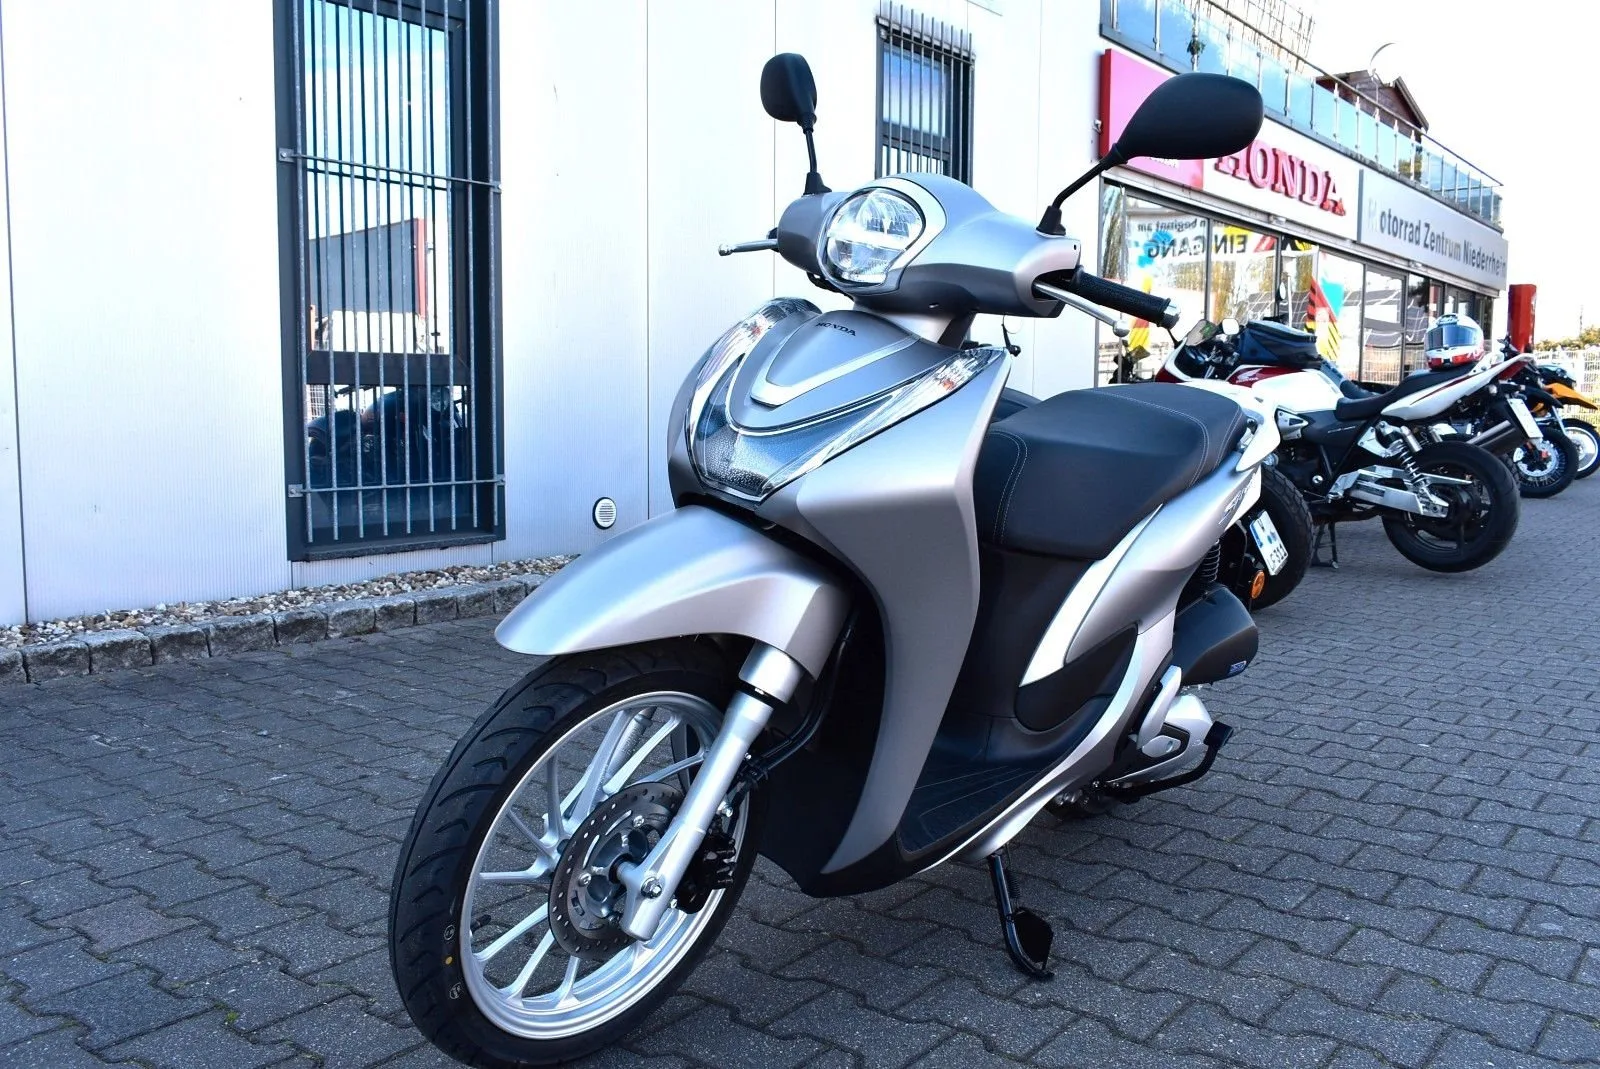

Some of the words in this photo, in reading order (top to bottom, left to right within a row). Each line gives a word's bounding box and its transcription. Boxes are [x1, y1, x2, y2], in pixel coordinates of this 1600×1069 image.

[1423, 222, 1461, 261] Zentrum
[1463, 239, 1506, 278] Niederrhein
[815, 322, 856, 336] HONDA
